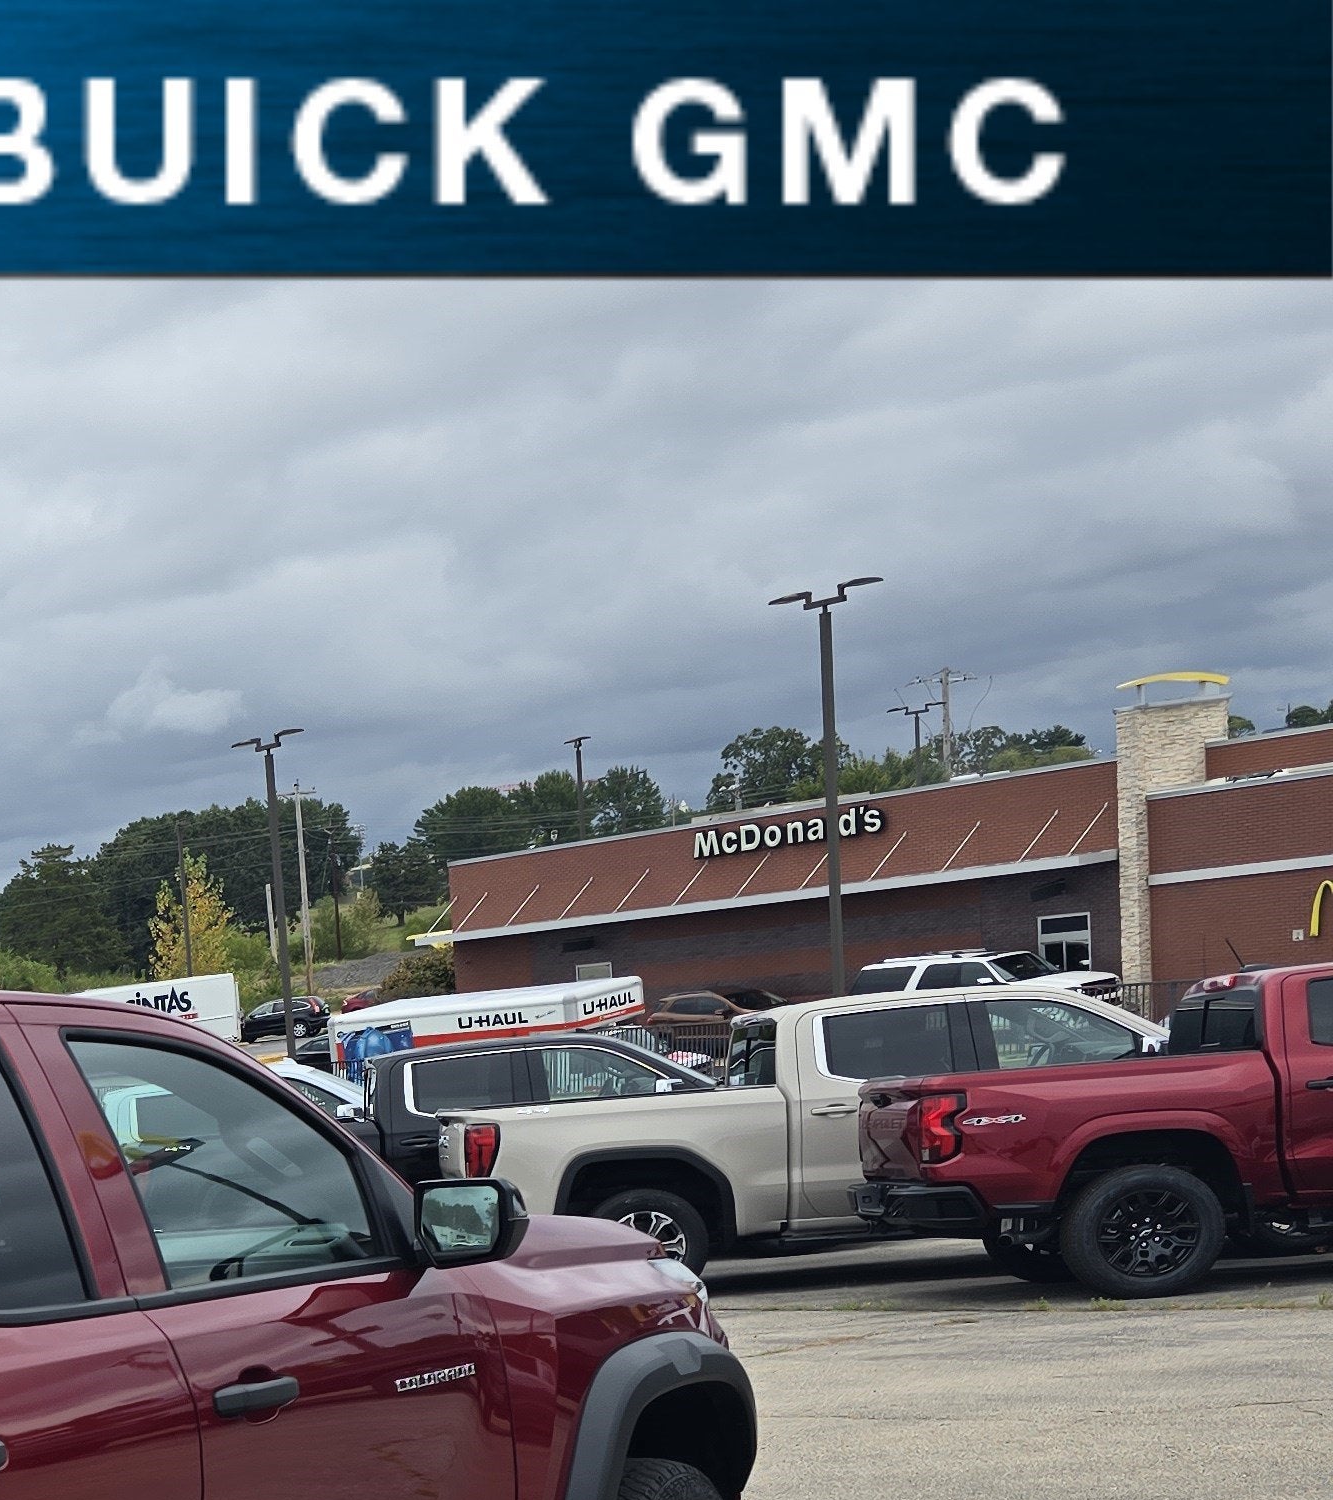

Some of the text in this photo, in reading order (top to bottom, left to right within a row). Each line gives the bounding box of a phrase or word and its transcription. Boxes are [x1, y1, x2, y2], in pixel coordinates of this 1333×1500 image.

[693, 806, 882, 859] McDonad's
[582, 991, 636, 1016] U-HAUL
[457, 1011, 529, 1029] U-HAUL
